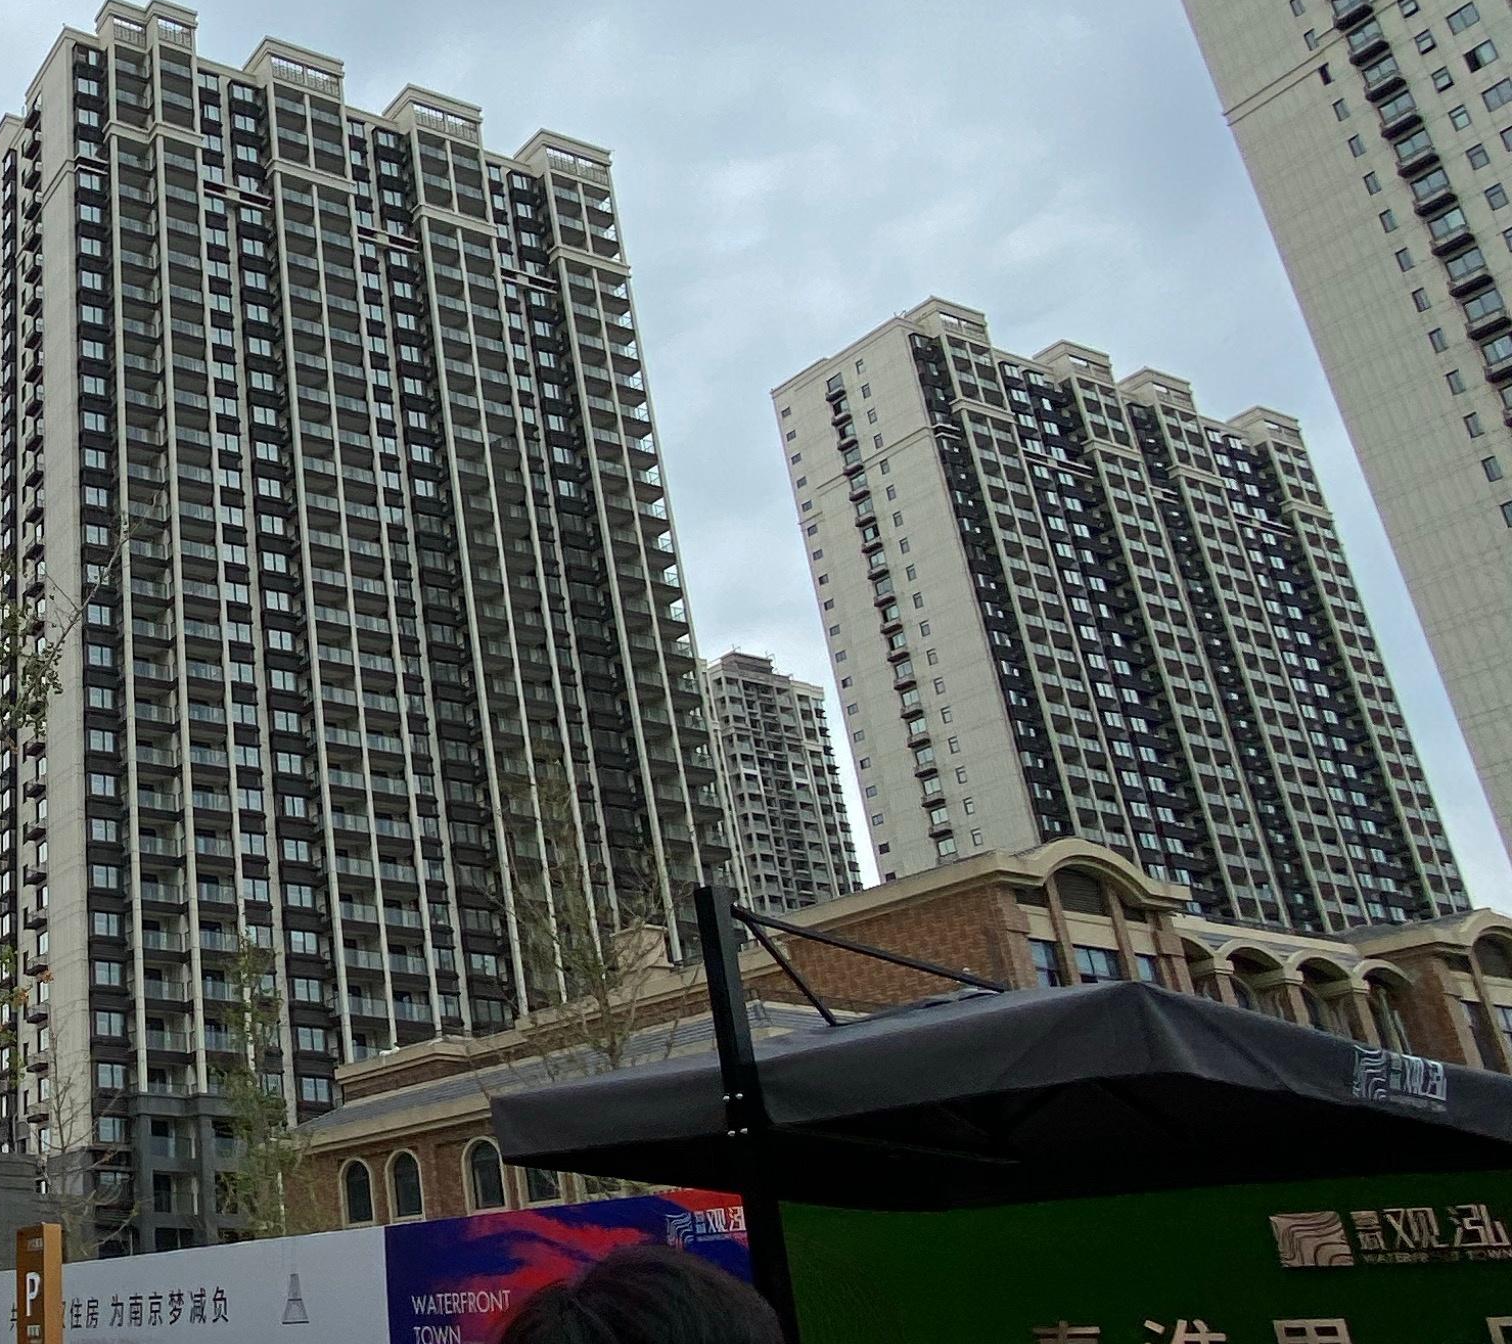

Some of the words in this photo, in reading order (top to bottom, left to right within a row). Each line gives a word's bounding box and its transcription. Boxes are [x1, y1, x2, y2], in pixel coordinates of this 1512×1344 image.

[25, 1271, 41, 1317] P
[108, 1285, 230, 1328] 为南京梦减负
[411, 1289, 511, 1316] WATERFRONT
